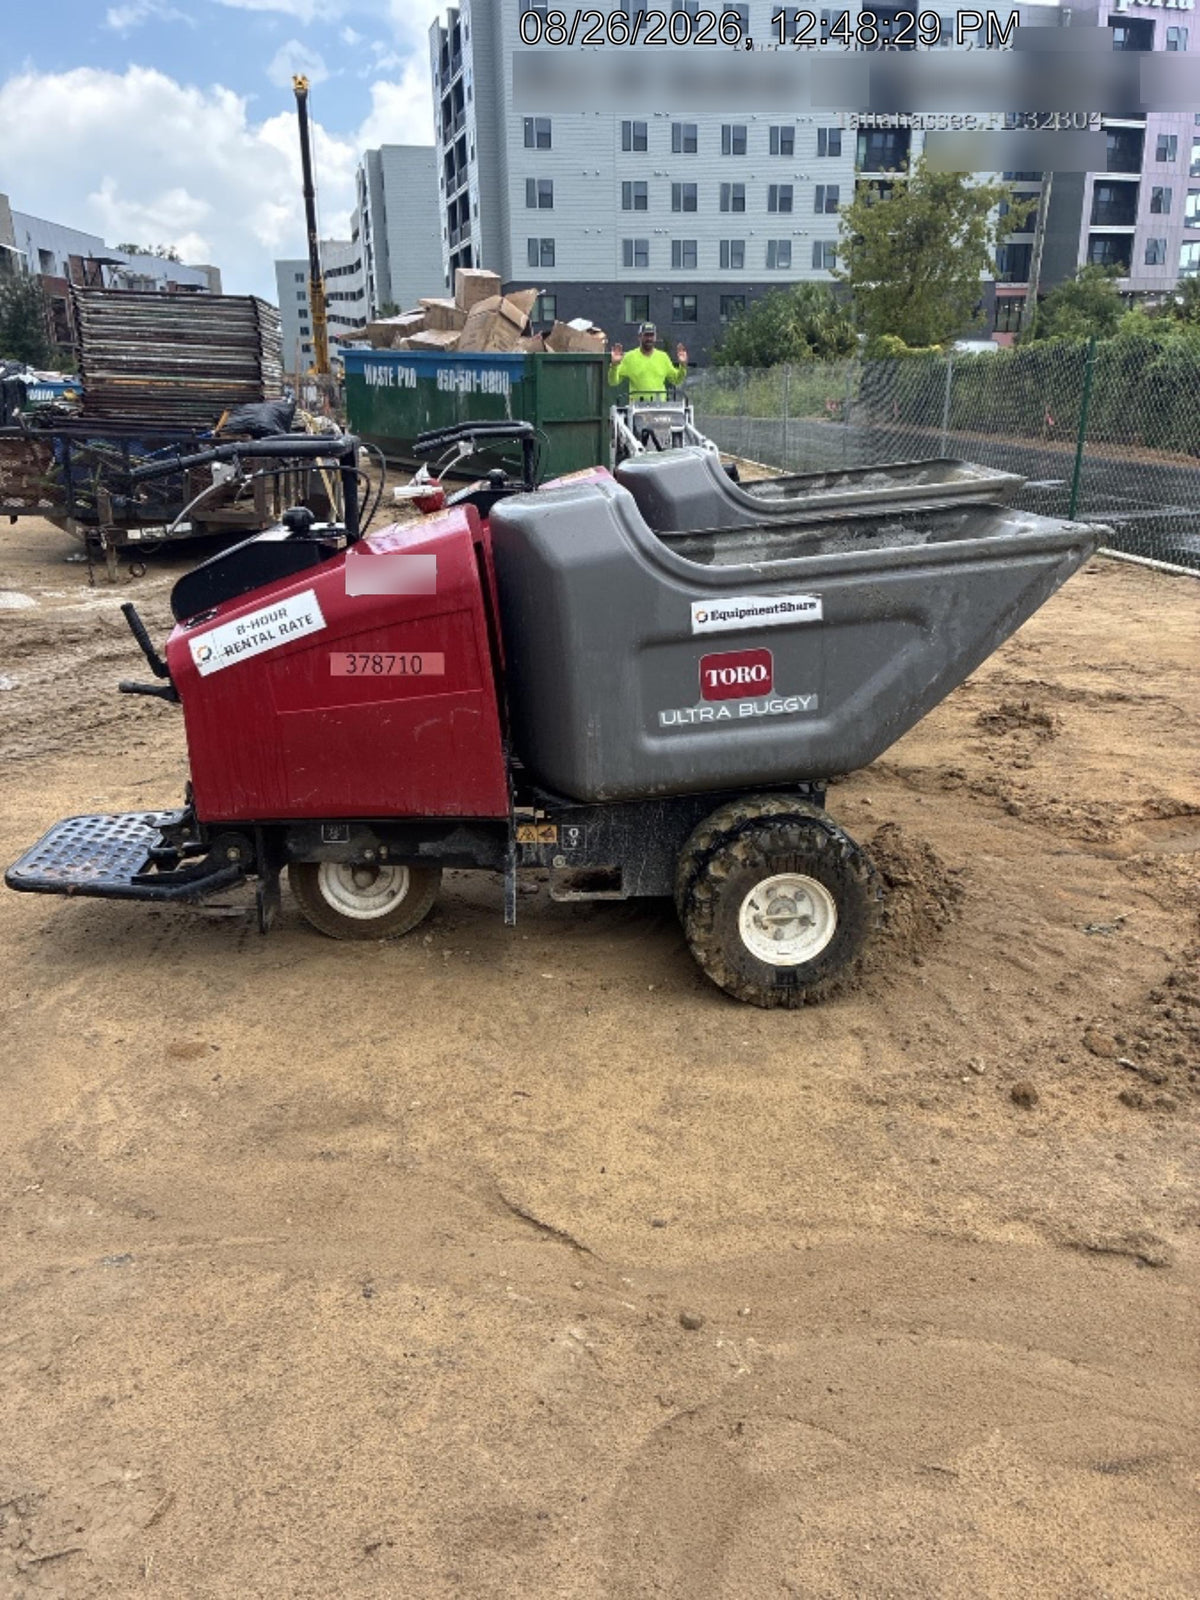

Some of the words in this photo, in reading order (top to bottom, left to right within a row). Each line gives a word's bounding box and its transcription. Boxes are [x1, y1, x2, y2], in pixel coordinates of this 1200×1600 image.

[363, 363, 395, 387] WASTE
[235, 607, 289, 635] 8-HOUR
[710, 601, 817, 622] EquipmentShare
[223, 629, 276, 657] RENTAL
[278, 613, 313, 636] RATE
[346, 653, 423, 674] 378710
[705, 664, 767, 688] TORO
[660, 705, 731, 725] ULTRA
[739, 695, 812, 717] BUGGY
